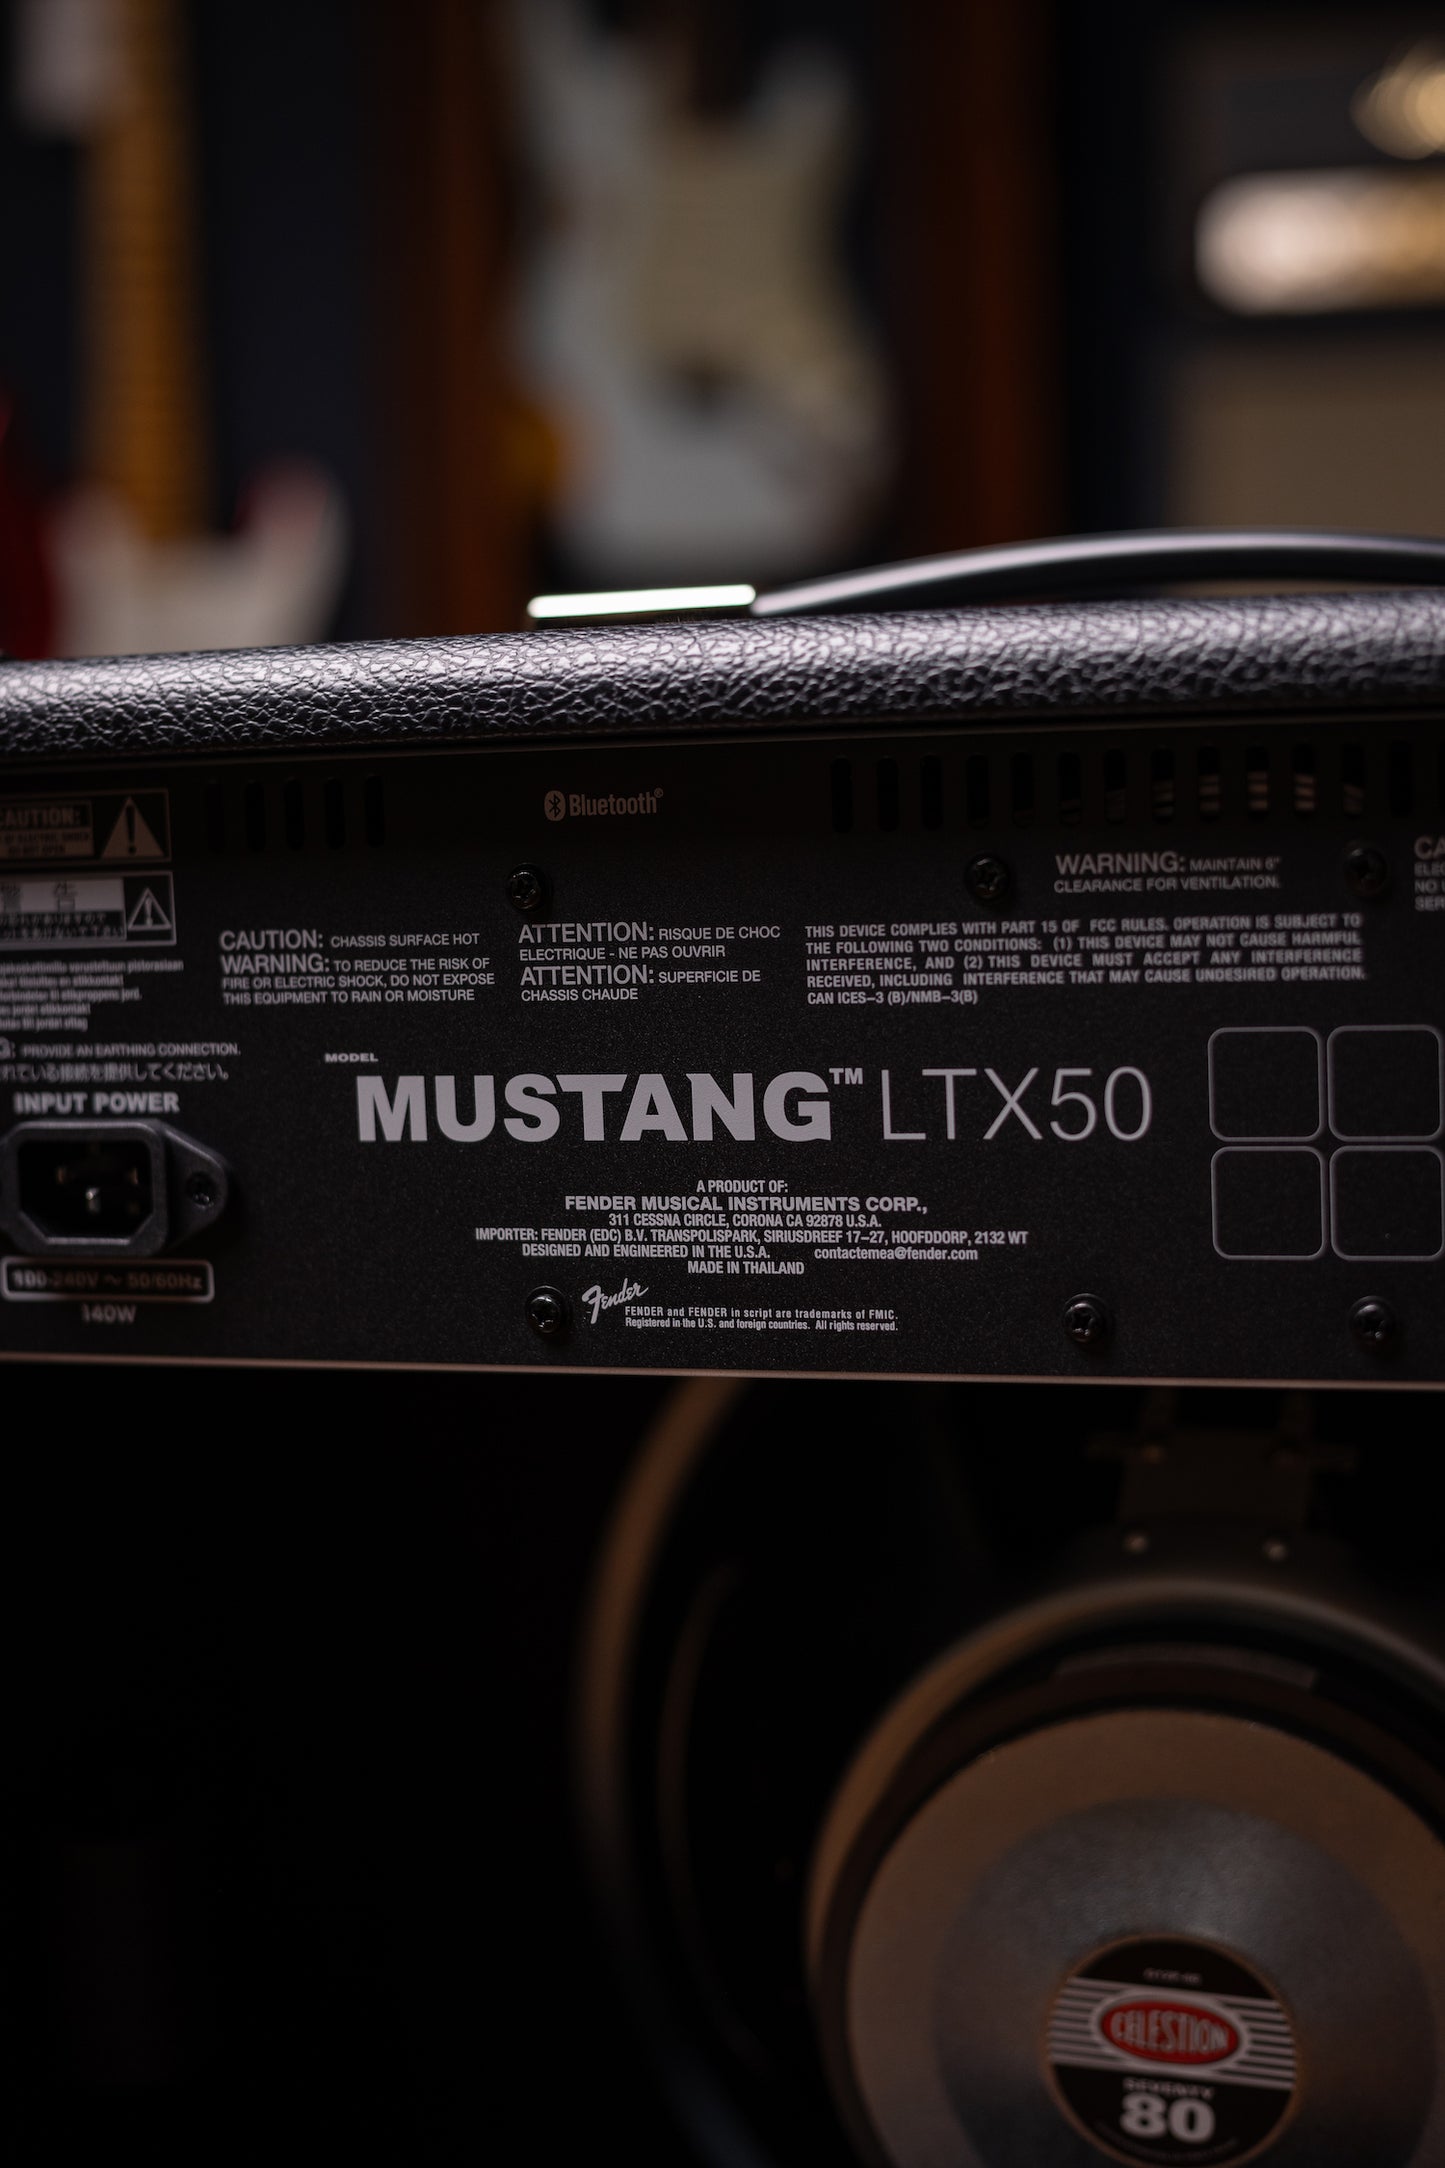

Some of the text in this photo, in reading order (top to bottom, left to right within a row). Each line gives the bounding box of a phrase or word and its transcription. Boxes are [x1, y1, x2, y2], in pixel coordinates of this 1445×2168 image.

[1055, 851, 1263, 875] WARNING: MAINTAIN
[1053, 874, 1281, 894] CLEARANCE FOR VENTILATION.
[518, 922, 781, 944] ATTENTION: RISQUE DE CHOC
[805, 913, 1338, 938] THIS DEVICE COMPLIES WITH PART OF FCC RULES. OPERATION SUBJECT
[220, 929, 480, 951] CAUTION: CHASSIS SURFACE HOT
[805, 931, 1287, 955] THE FOLLOWING TWO CONDITIONS: THIS DEVICE MAY NOT CAUSE
[221, 952, 490, 975] WARNING: TO REDUCE THE RISK OF
[519, 945, 726, 962] ELECTRIQUE NE PAS OUVRIR
[806, 947, 1363, 972] INTERFERENCE, AND (2) THIS DEVICE MUST ACCEPT ANY INTERFERENCE
[222, 972, 495, 990] FIRE OR ELECTRIC SHOCK, DO NOT EXPOSE
[520, 964, 761, 986] ATTENTION: SUPERFICIE DE
[807, 965, 1366, 989] RECEIVED, INCLUDING INTERFERENCE THAT MAY CAUSE UNDESIRED OPERATION.
[223, 989, 475, 1005] THIS EQUIPMENT TO RAIN OR MOISTURE
[521, 988, 639, 1002] CHASSIS CHAUDE
[807, 992, 834, 1005] CAN
[20, 1042, 241, 1058] PROVIDE AN EARTHING CONNECTION.
[324, 1053, 378, 1063] MODEL
[12, 1091, 181, 1115] INPUT POWER
[880, 1066, 1152, 1142] LTX50
[696, 1180, 788, 1193] A PRODUCT OF:
[565, 1195, 928, 1214] FENDER MUSICAL INSTRUMENTS CORP.,
[609, 1214, 882, 1228] 311 CESSNA CIRCLE, CORONA CA 92878 U.S.A.
[475, 1228, 538, 1241] IMPORTER:
[541, 1228, 587, 1242] FENDER
[590, 1229, 622, 1244] (EDC)
[625, 1229, 647, 1242] B.V.
[650, 1229, 761, 1244] TRANSPOLISPARK,
[763, 1230, 843, 1244] SIRIUSDREEF
[891, 1231, 972, 1245] HOOFDDORP,
[974, 1230, 1005, 1244] 2132
[1008, 1231, 1028, 1244] WT
[522, 1244, 978, 1261] DESIGNED AND ENGINEERED IN THE U.S.A. contactemea@fender.com
[687, 1260, 805, 1275] MADE IN THAILAND
[582, 1278, 648, 1324] Fender
[81, 1304, 137, 1324] 140W
[625, 1306, 898, 1320] FENDER and FENDER in script are trademarks of FMIC.
[625, 1317, 898, 1332] Registered U.S. and foreign countries. All rights reserved.
[1110, 2009, 1229, 2054] CELESTION
[1120, 2091, 1216, 2144] 80
